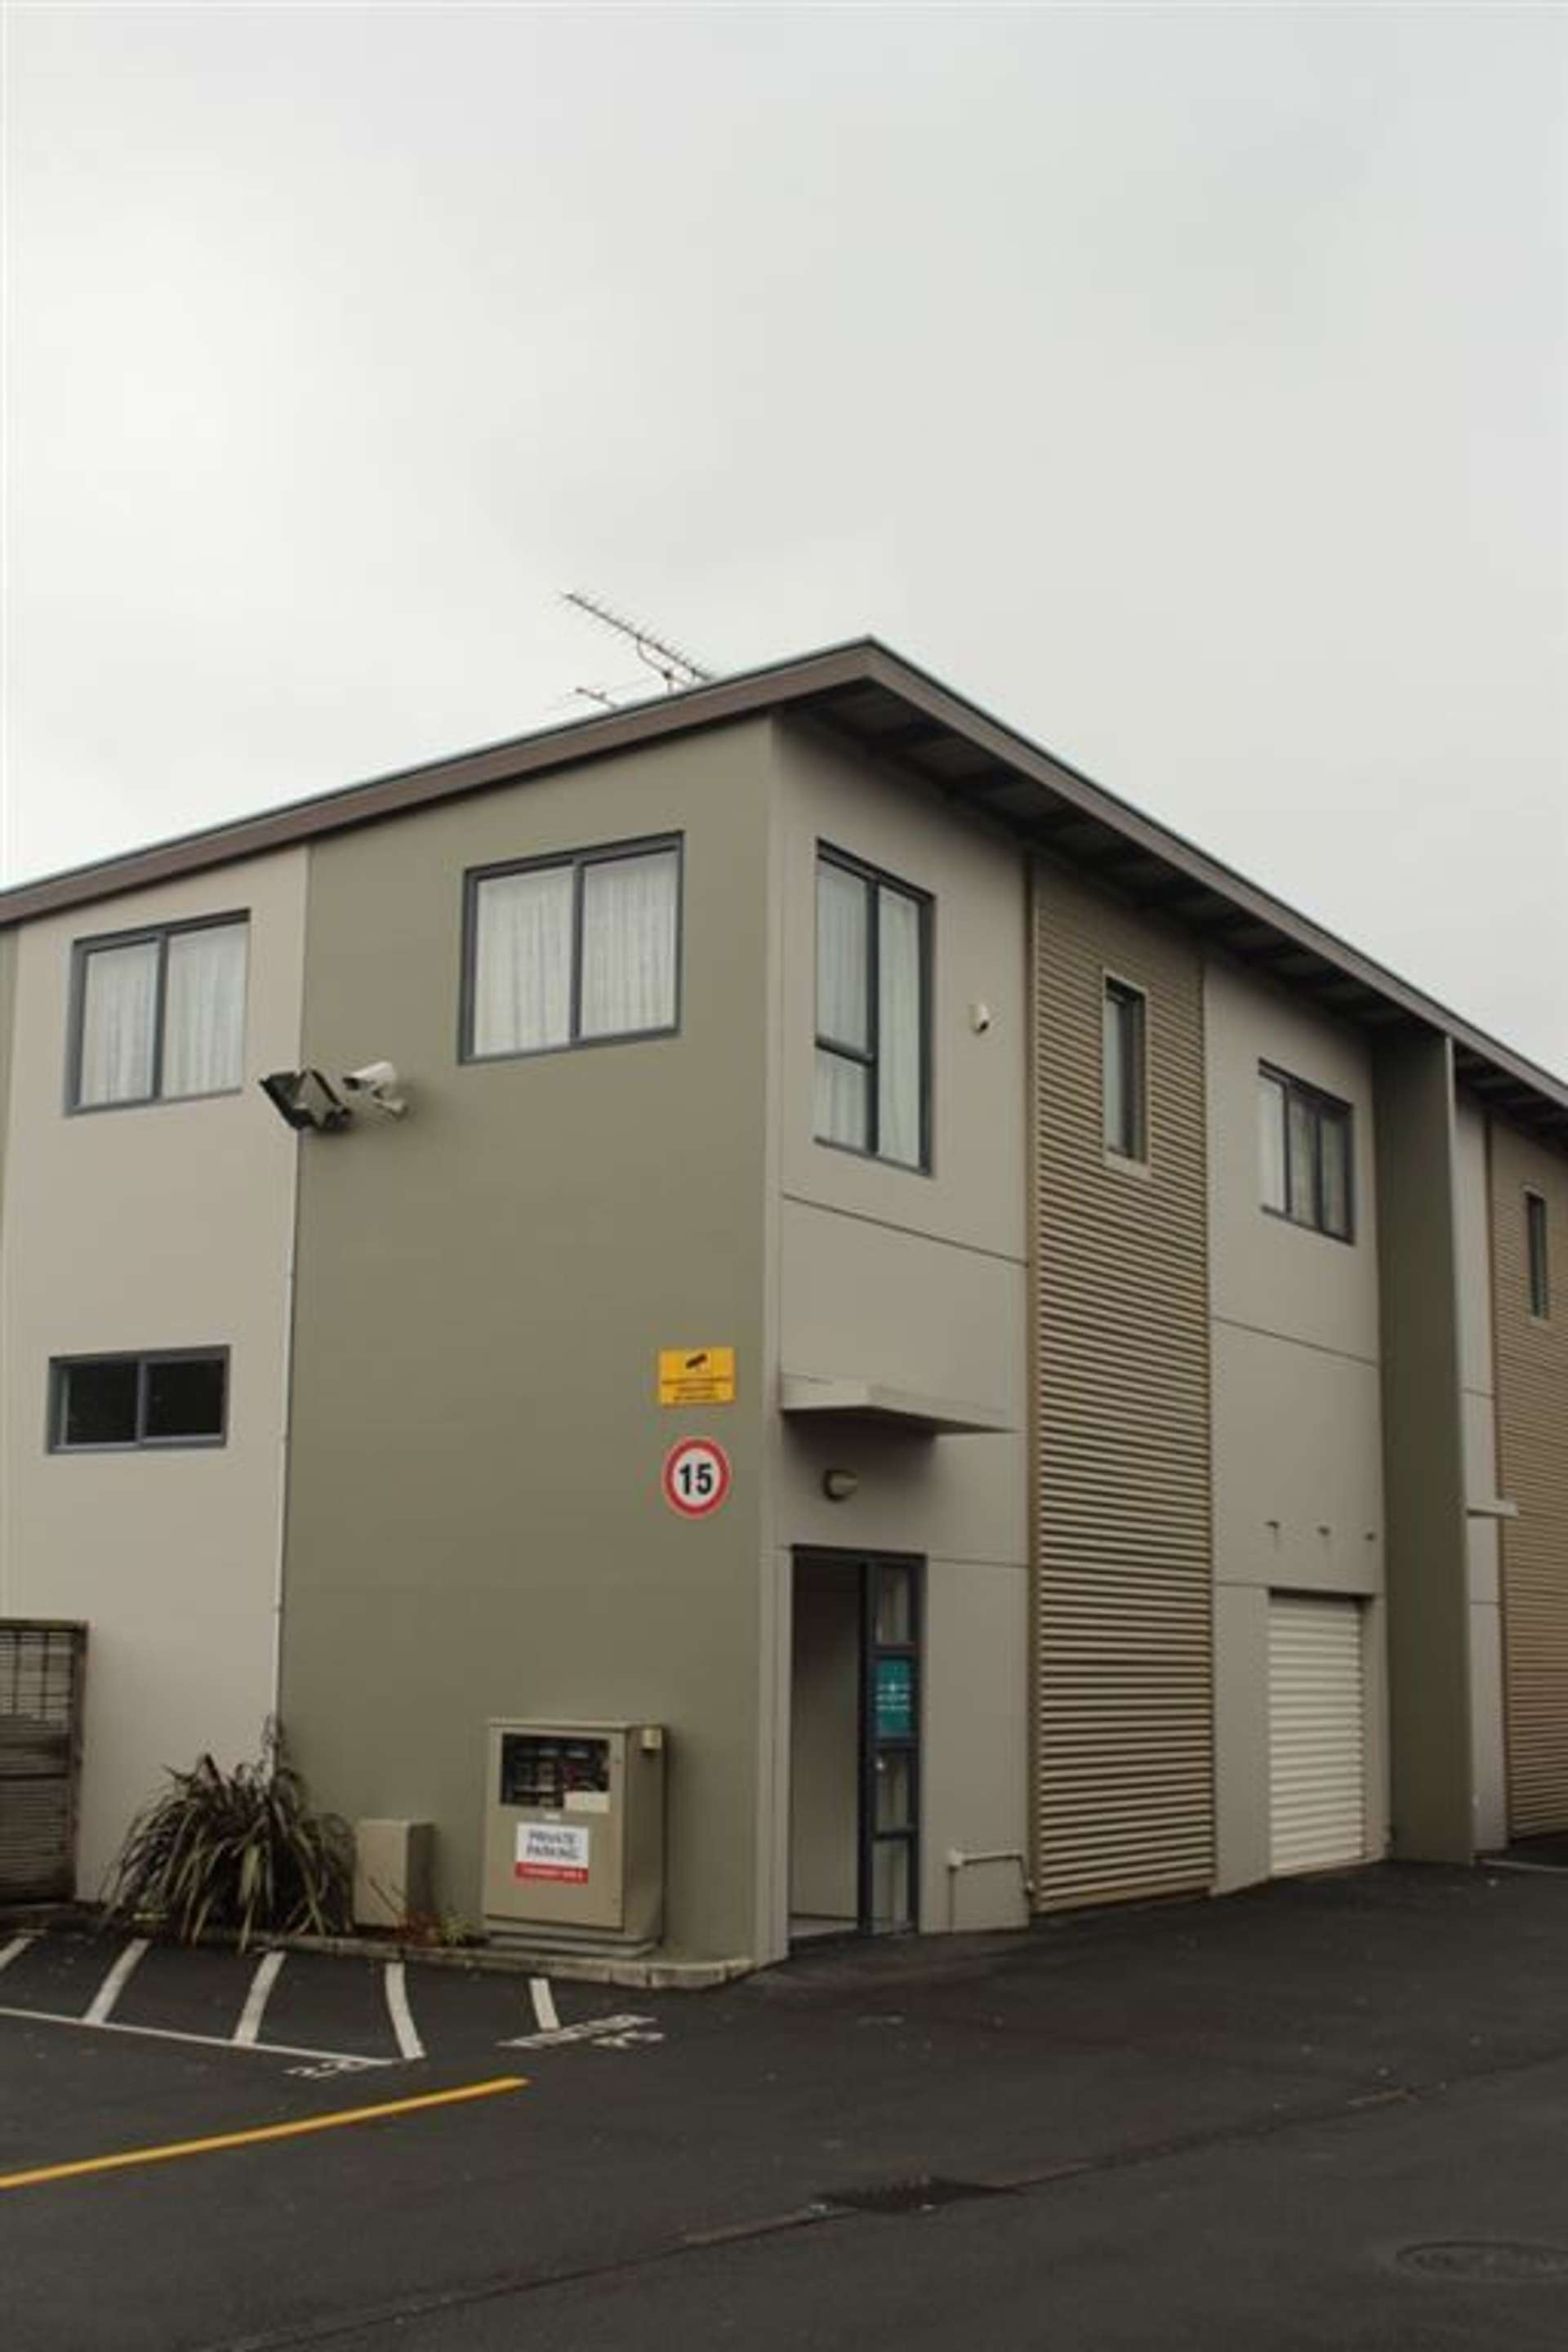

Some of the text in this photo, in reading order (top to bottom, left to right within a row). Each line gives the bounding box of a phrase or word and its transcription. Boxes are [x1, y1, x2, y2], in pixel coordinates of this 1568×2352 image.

[679, 1463, 712, 1495] 15
[528, 1829, 577, 1845] PRIVATE
[526, 1844, 581, 1861] PARKING
